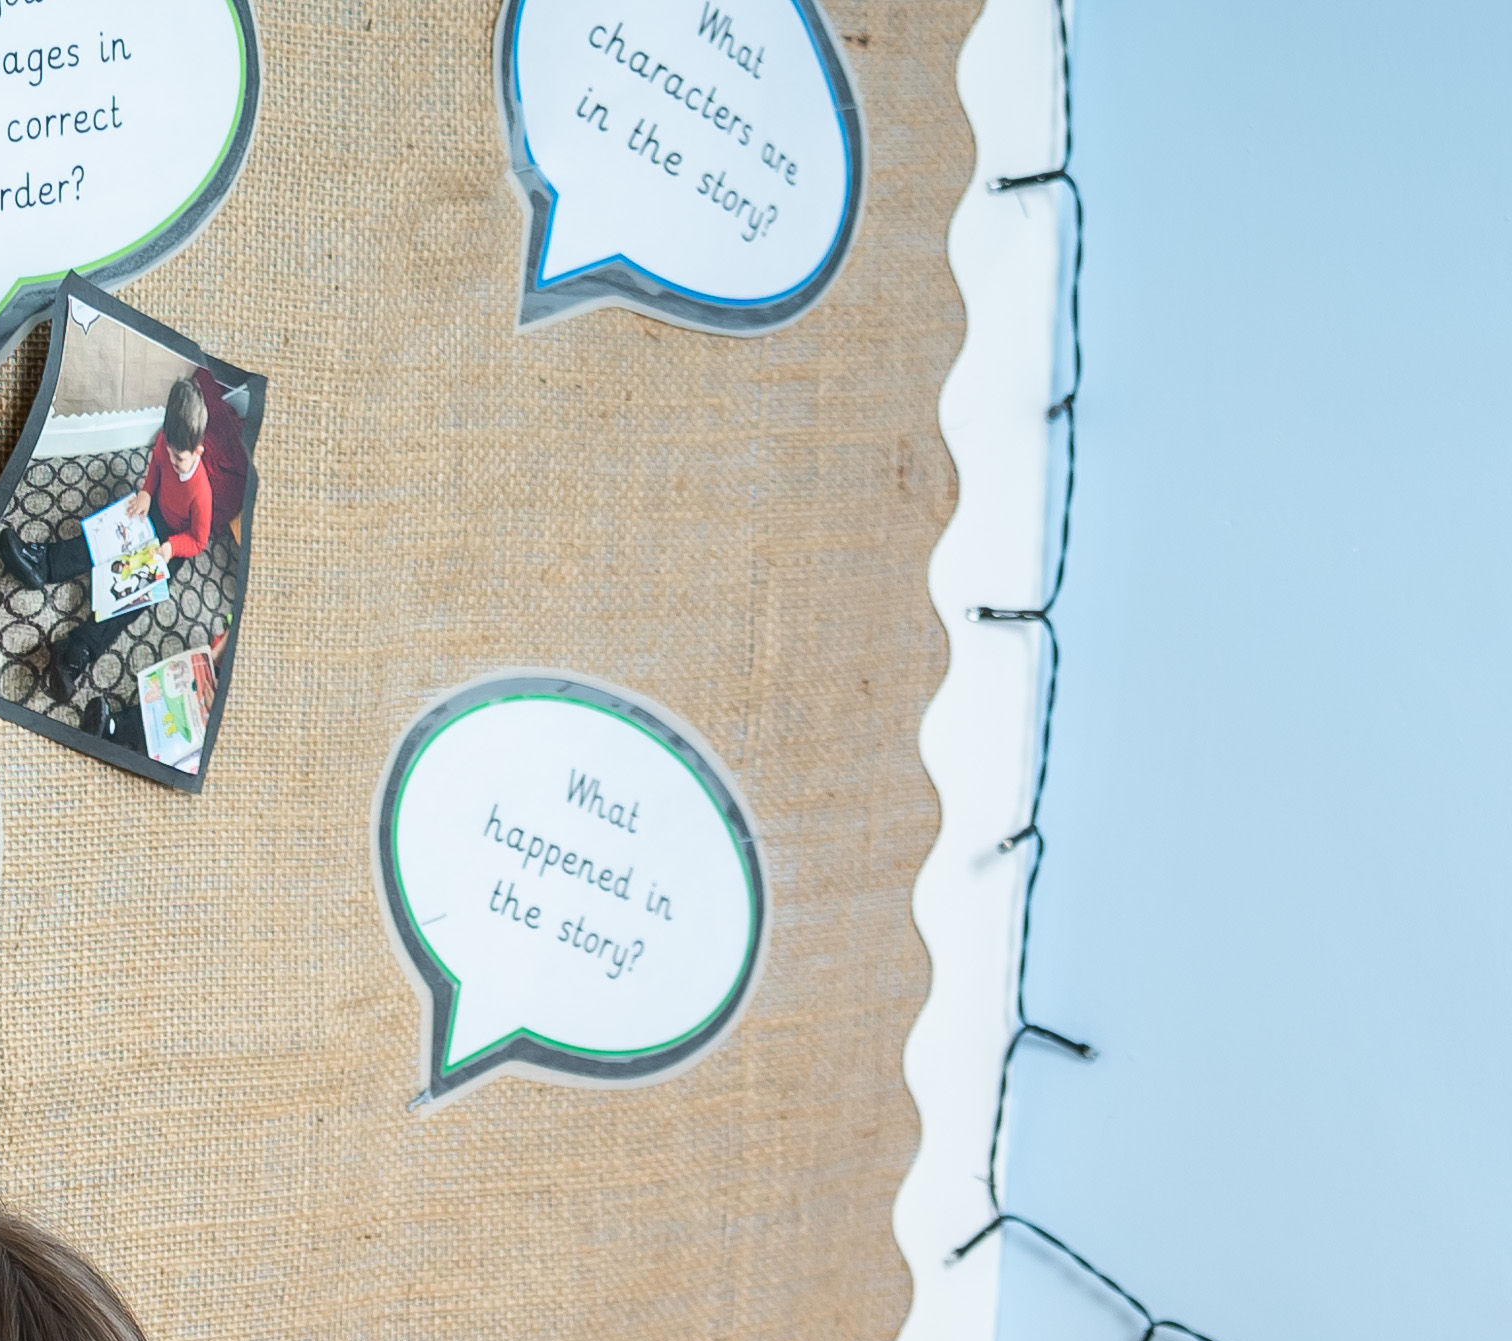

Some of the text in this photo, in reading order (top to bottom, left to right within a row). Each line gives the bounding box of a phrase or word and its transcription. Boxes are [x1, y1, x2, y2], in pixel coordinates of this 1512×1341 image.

[99, 31, 132, 62] in
[697, 1, 766, 79] What
[7, 96, 123, 144] correct
[588, 22, 798, 186] characters are
[575, 87, 778, 242] in the story?
[566, 768, 641, 834] What
[483, 803, 674, 922] happened in
[488, 879, 646, 980] the story?
